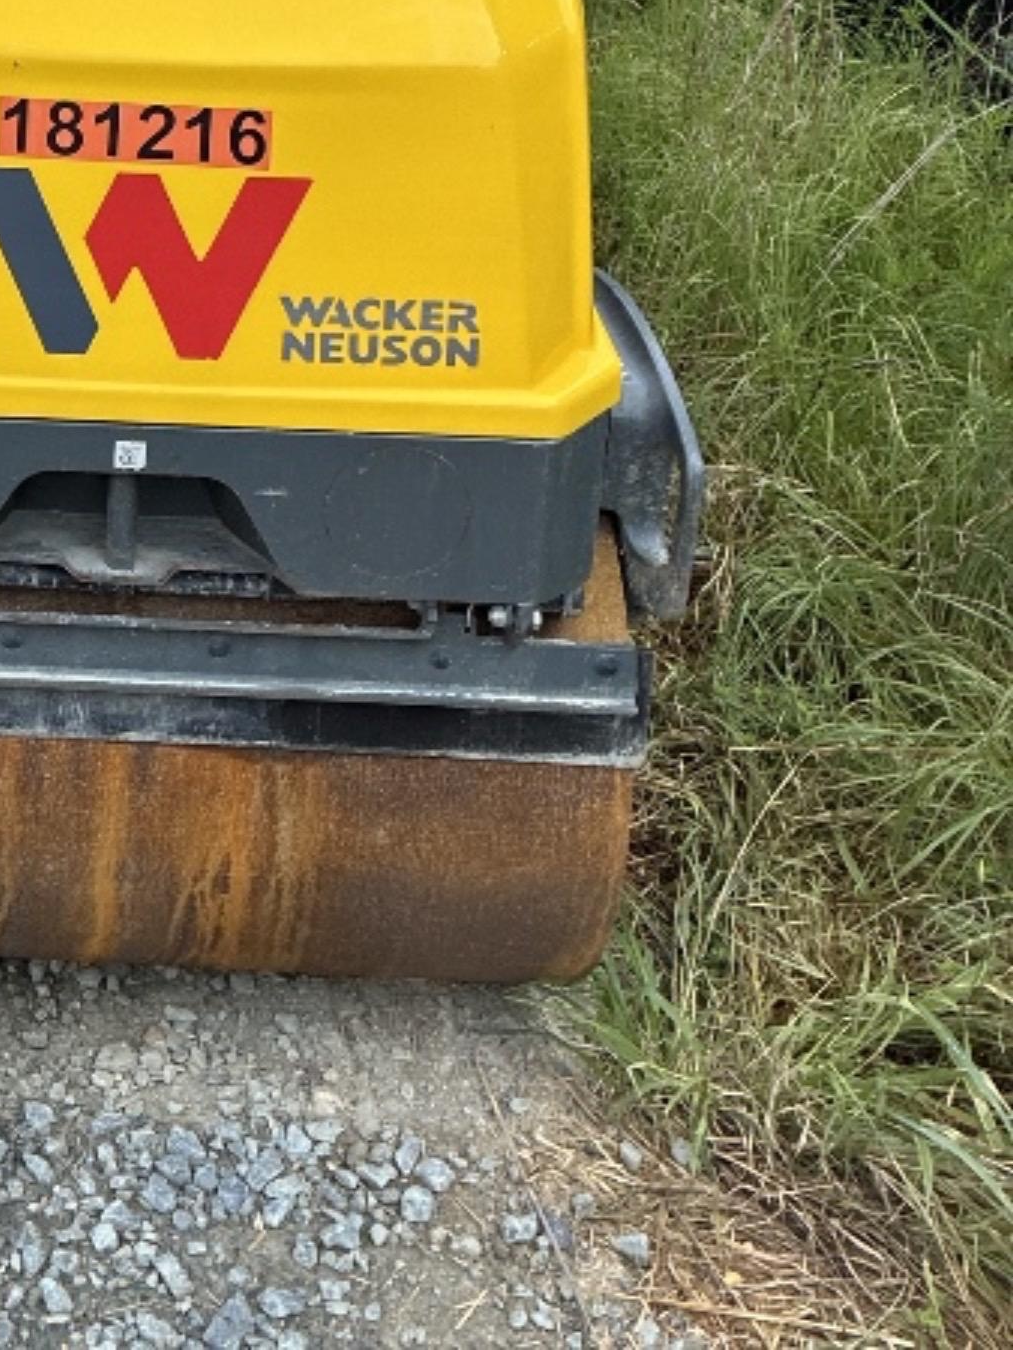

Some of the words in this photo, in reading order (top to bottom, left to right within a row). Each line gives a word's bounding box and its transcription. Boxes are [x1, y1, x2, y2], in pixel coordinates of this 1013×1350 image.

[2, 98, 267, 165] 181216
[280, 296, 480, 333] WACKER
[280, 332, 480, 368] NEUSON
